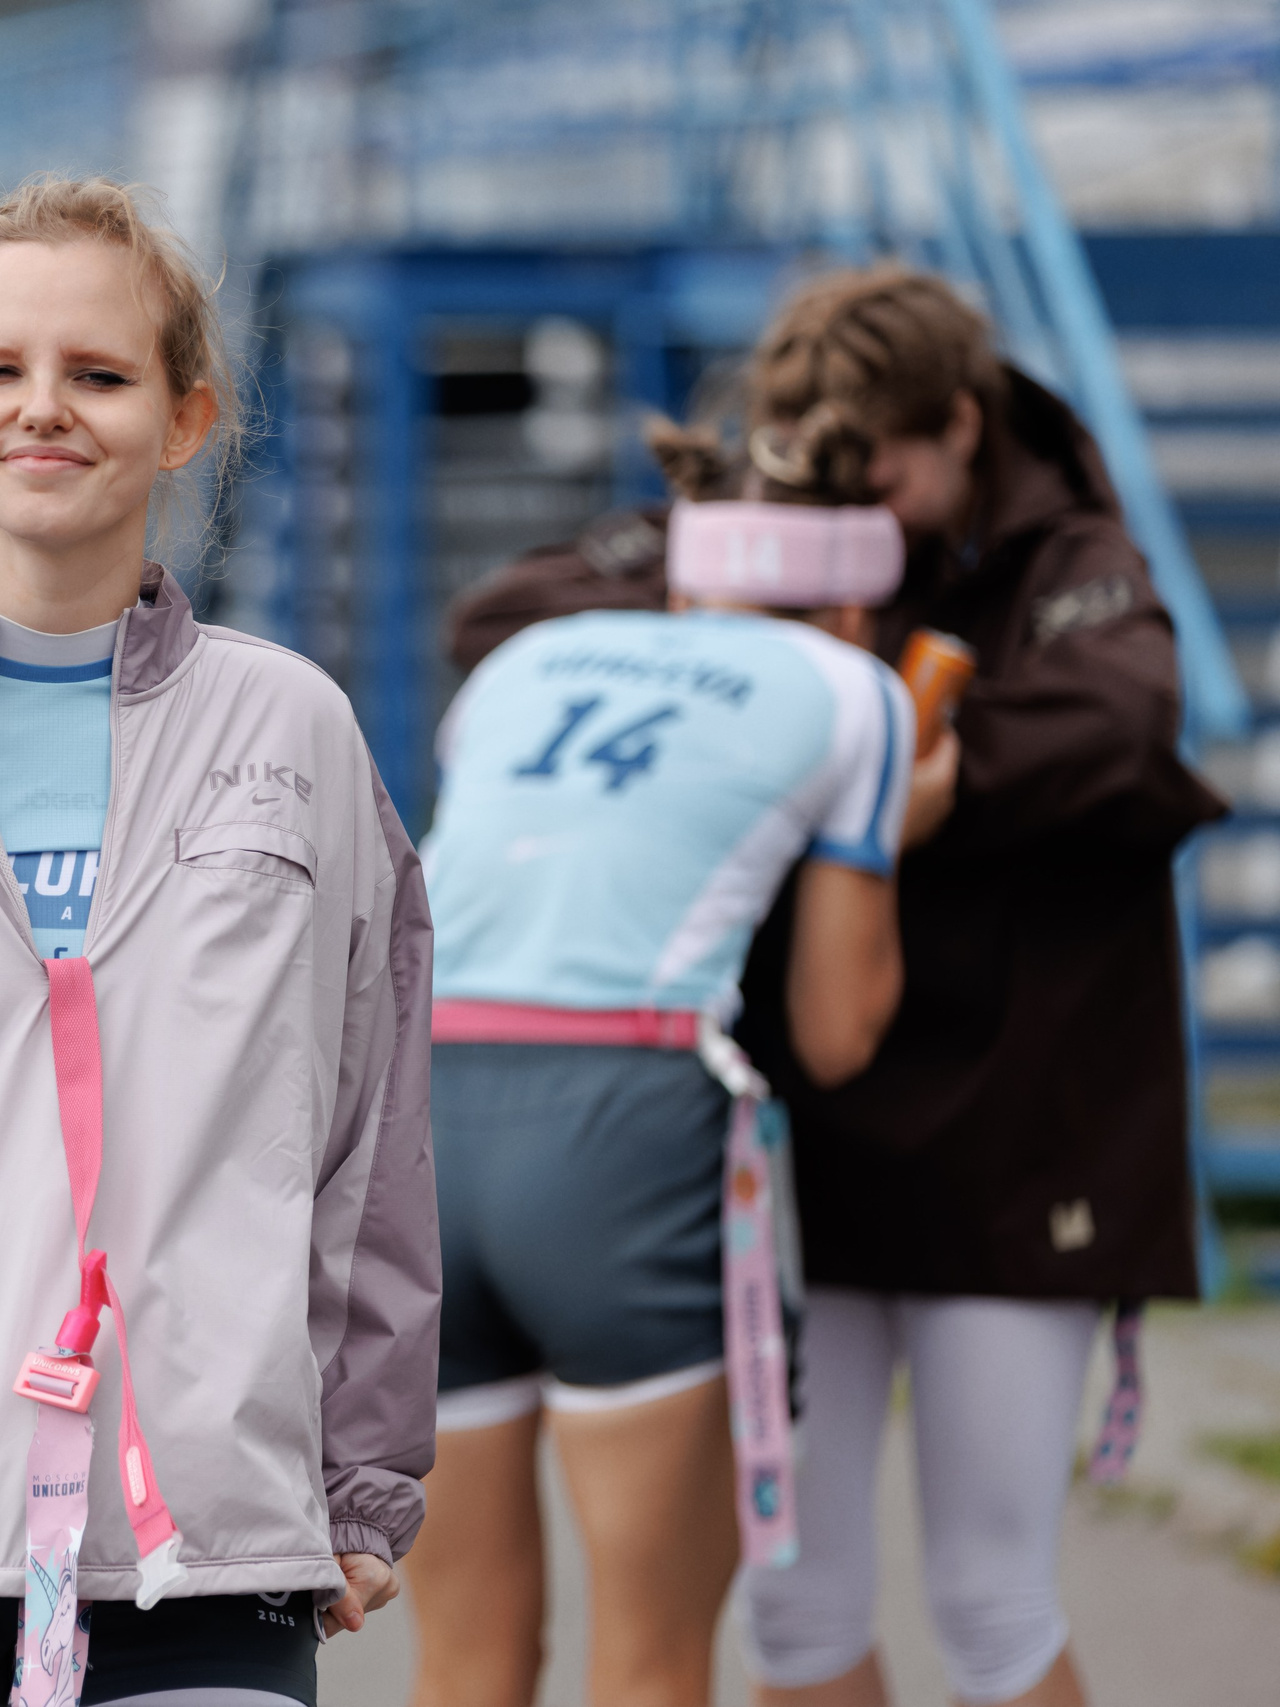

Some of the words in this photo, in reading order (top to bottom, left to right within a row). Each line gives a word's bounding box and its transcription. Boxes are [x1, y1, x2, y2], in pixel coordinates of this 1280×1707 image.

[512, 694, 682, 795] 14
[209, 761, 313, 806] NIKE
[61, 906, 72, 920] A
[32, 1358, 81, 1377] UNICORNS
[32, 1480, 86, 1498] UNICORNS
[257, 1610, 295, 1627] 2015
